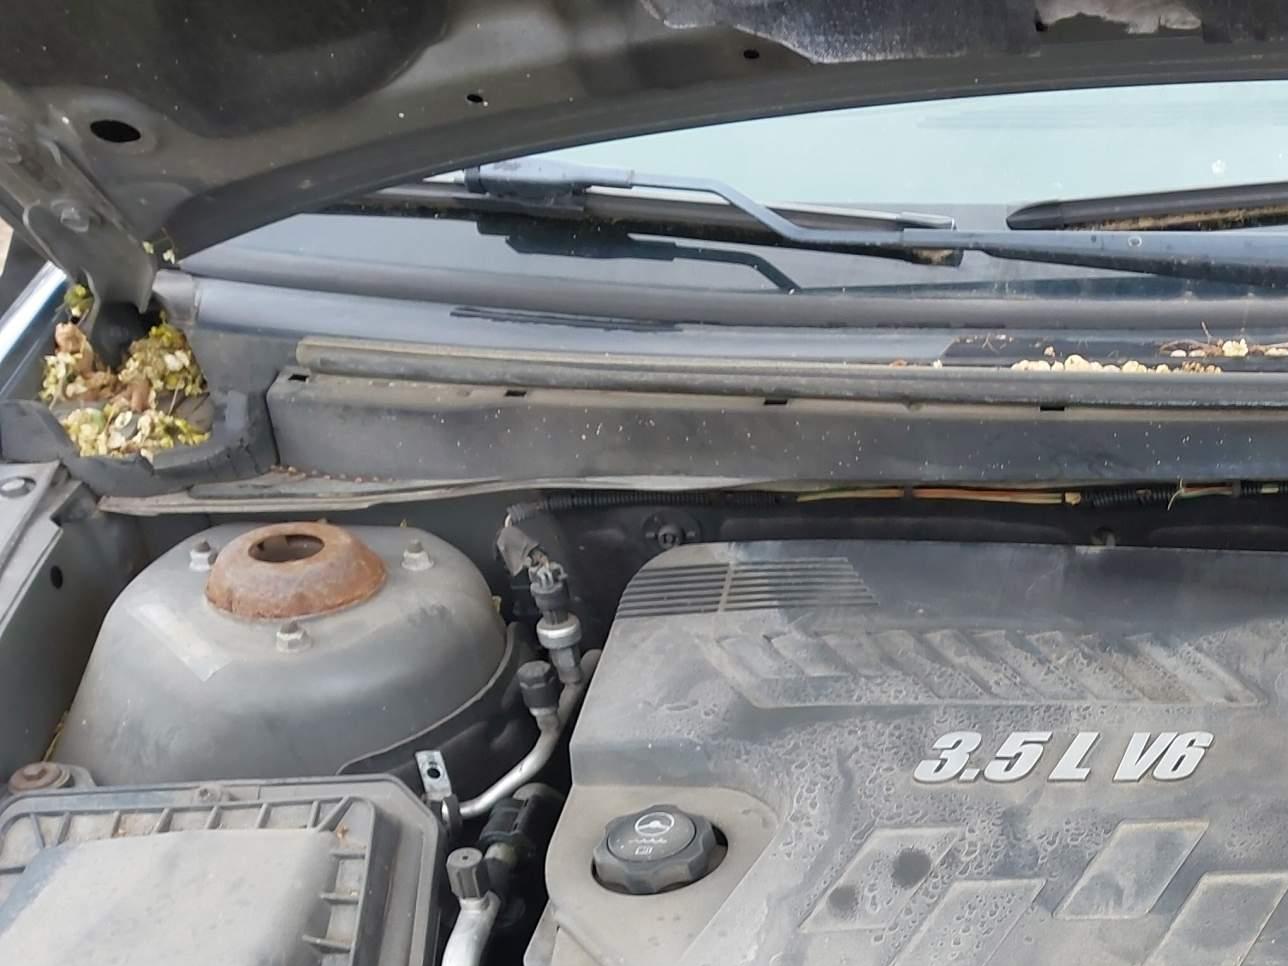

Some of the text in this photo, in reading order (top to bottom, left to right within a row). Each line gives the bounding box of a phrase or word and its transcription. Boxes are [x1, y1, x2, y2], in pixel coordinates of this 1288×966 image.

[914, 731, 1215, 783] 3.5 L V6
